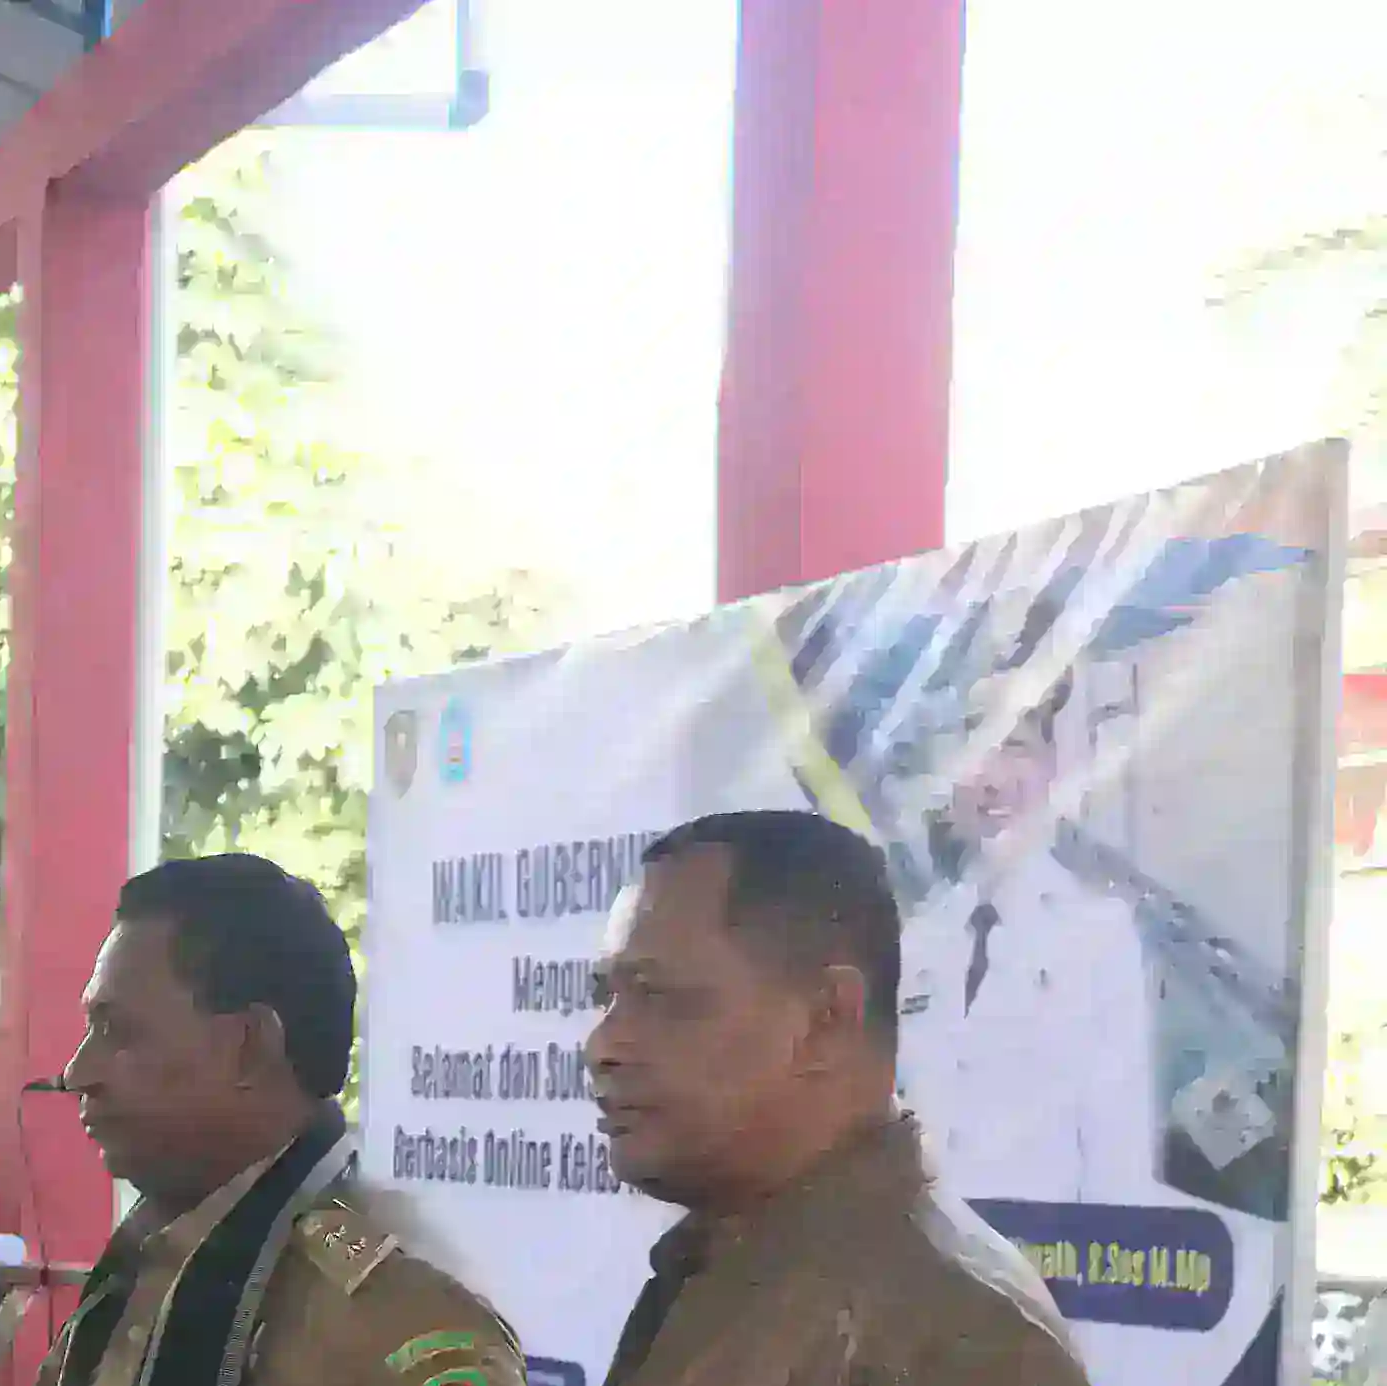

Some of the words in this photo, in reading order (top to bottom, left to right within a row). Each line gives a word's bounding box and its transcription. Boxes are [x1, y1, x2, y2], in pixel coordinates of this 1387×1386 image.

[432, 853, 508, 924] WAKIL
[411, 1044, 494, 1100] Selamat
[499, 1043, 541, 1101] dan
[545, 1041, 598, 1101] Suk
[393, 1124, 478, 1185] Berbasis
[483, 1127, 552, 1190] Online
